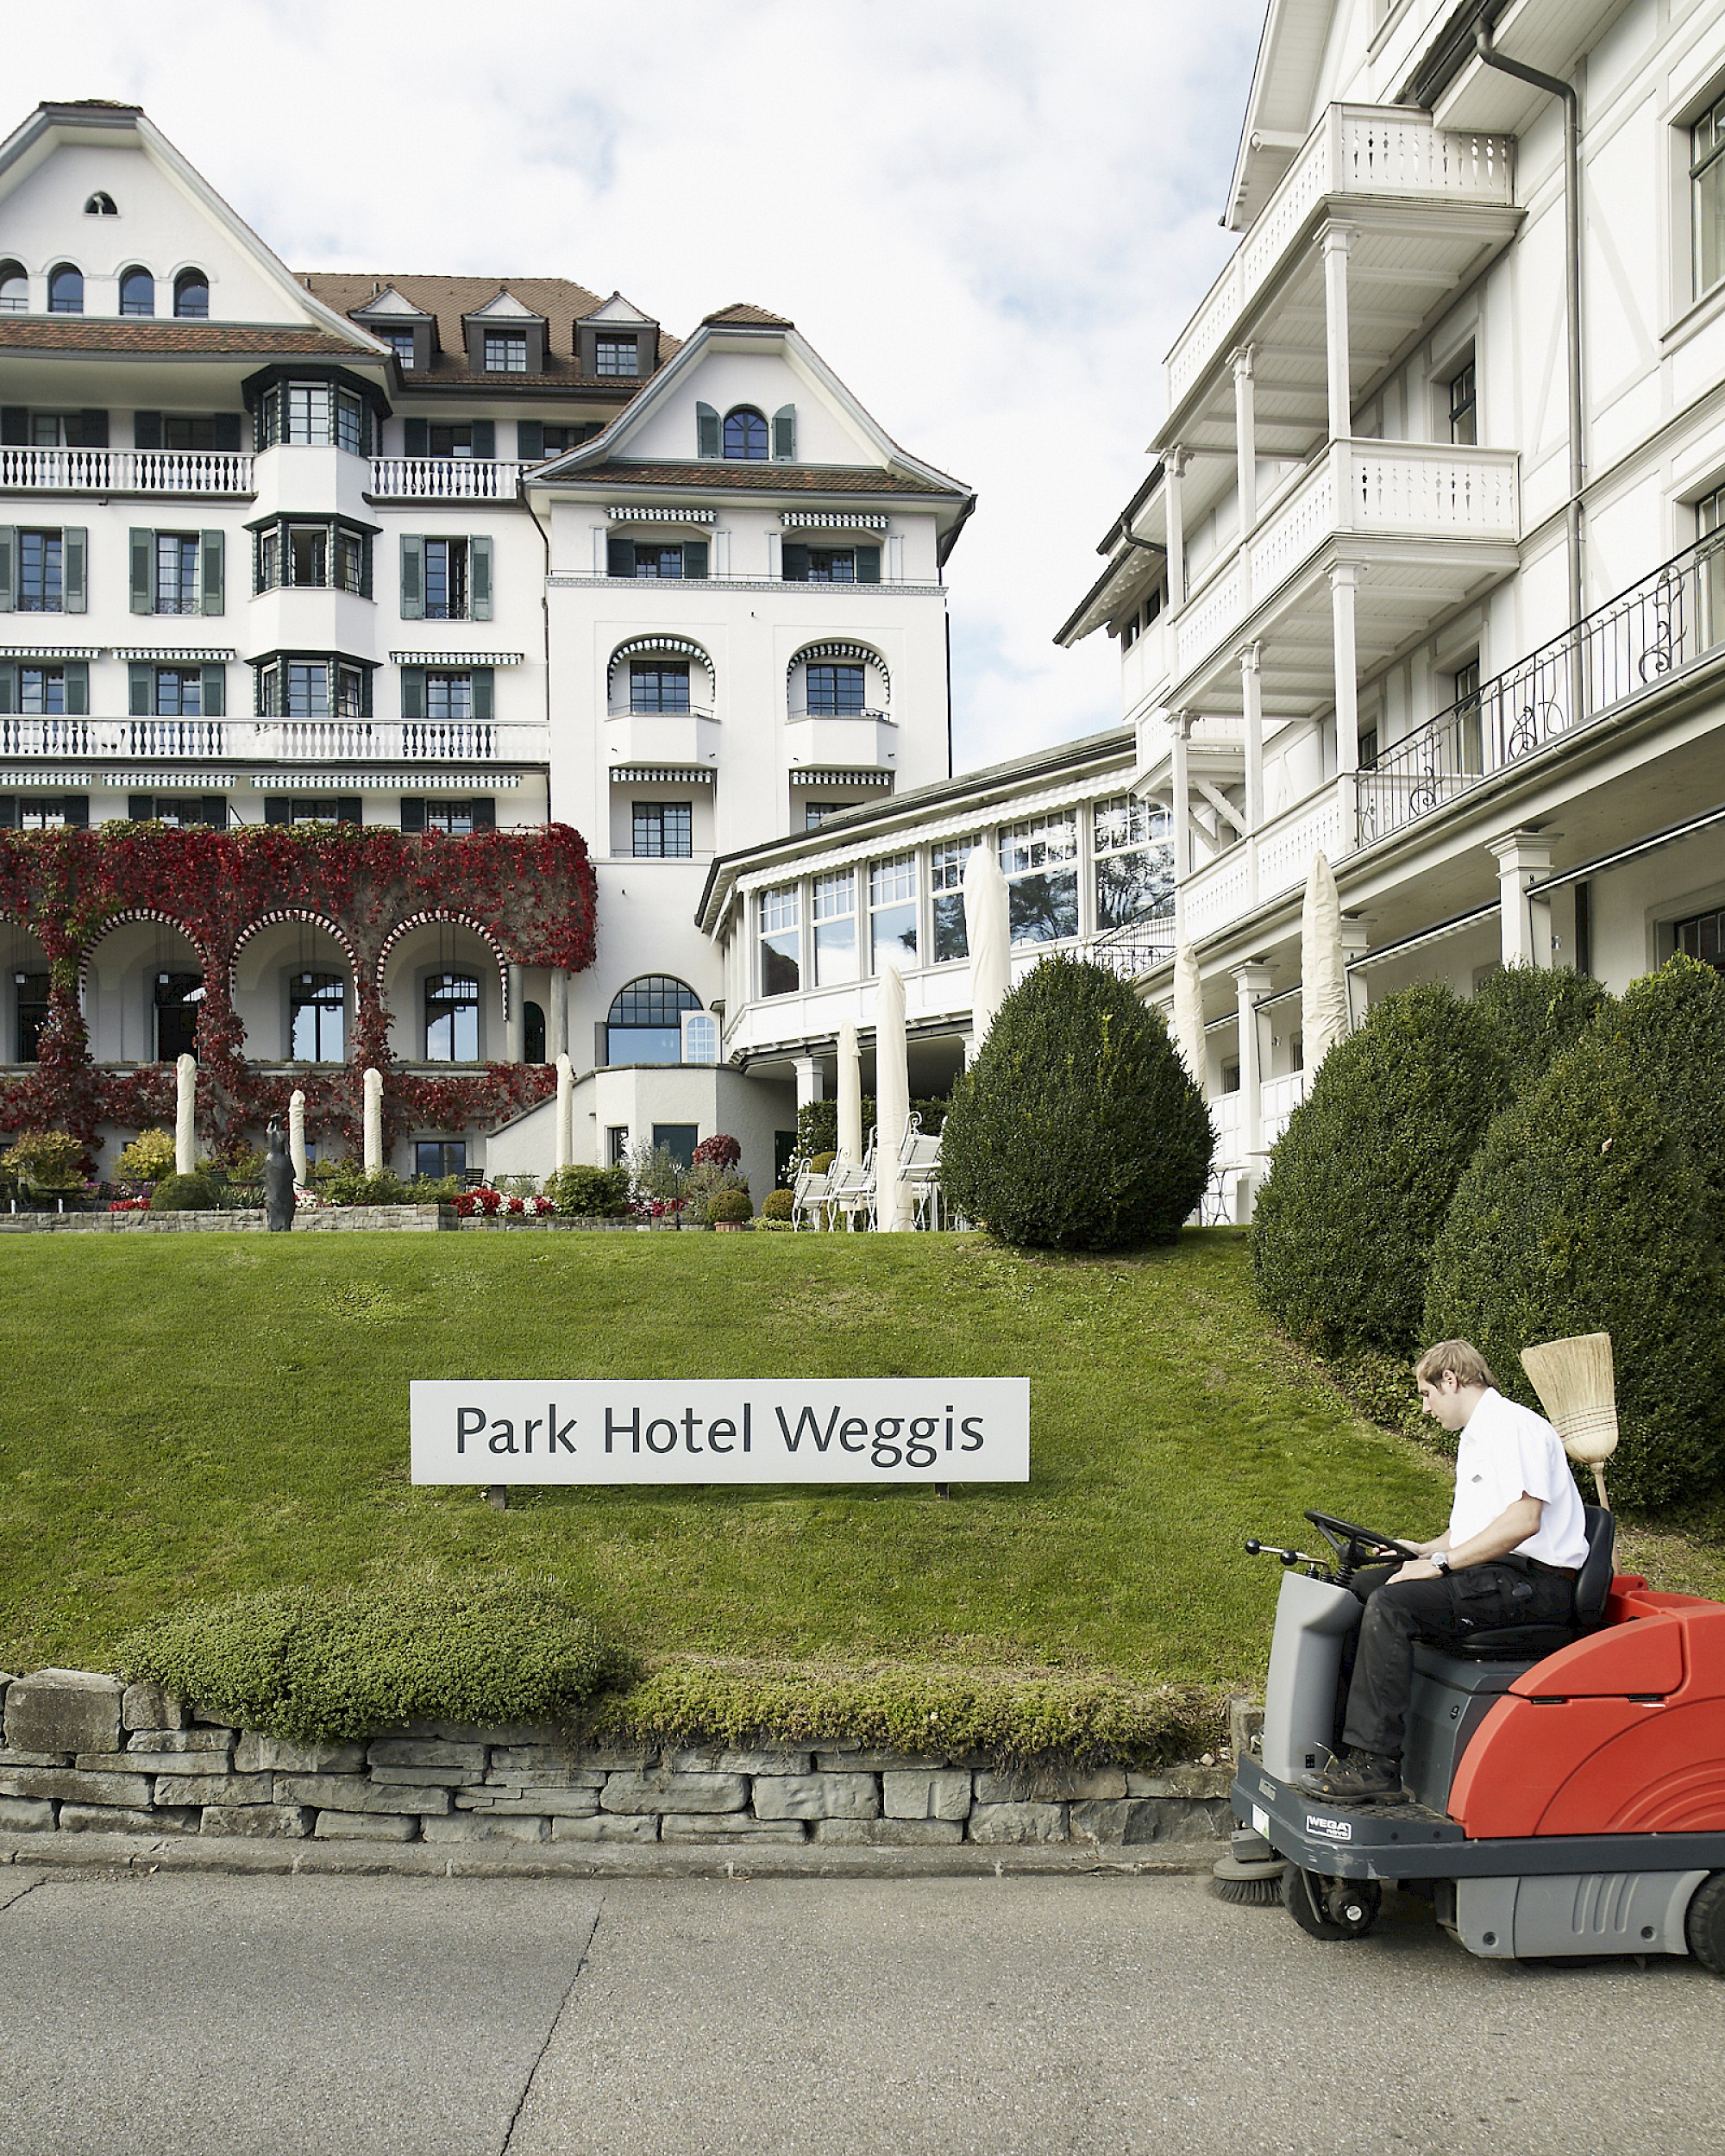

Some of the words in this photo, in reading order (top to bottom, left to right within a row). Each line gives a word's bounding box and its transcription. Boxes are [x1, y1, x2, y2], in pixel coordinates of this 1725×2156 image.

[457, 1403, 577, 1454] Park
[605, 1402, 751, 1453] Hotel
[775, 1405, 984, 1468] Weggis
[1310, 1816, 1348, 1831] WEGA
